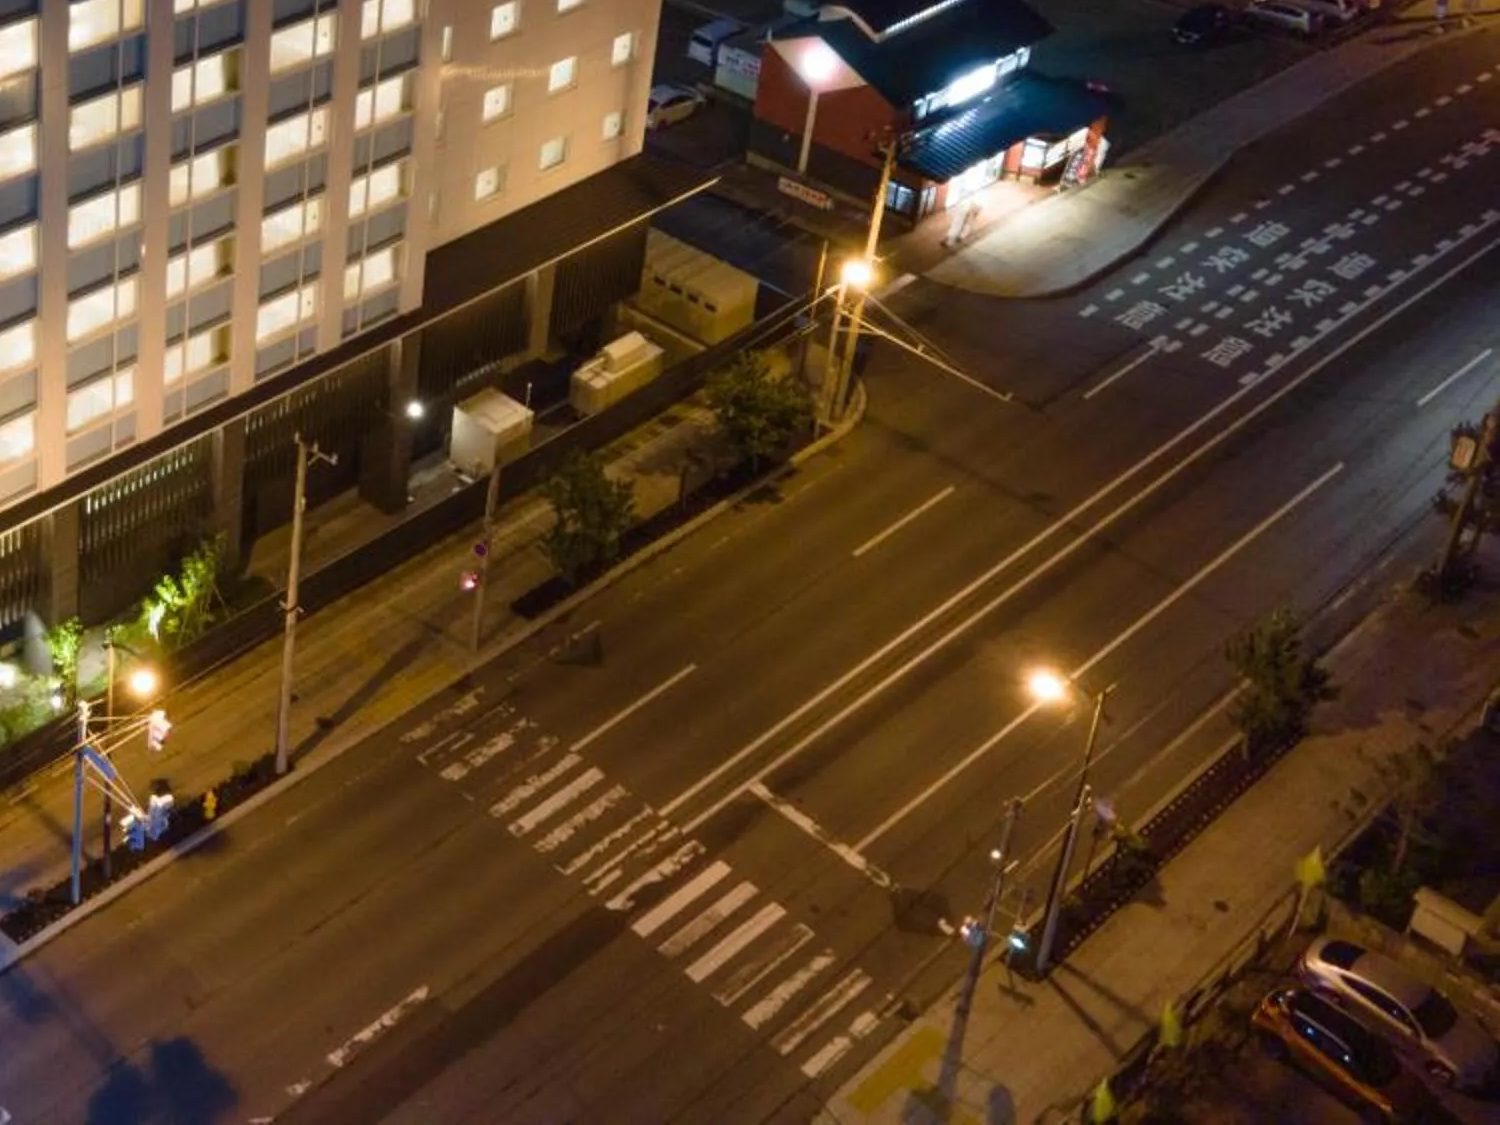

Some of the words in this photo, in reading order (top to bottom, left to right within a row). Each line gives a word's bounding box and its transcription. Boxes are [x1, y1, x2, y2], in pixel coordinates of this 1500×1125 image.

[1114, 220, 1290, 330] 追突注意
[1200, 251, 1376, 368] 追突注意
